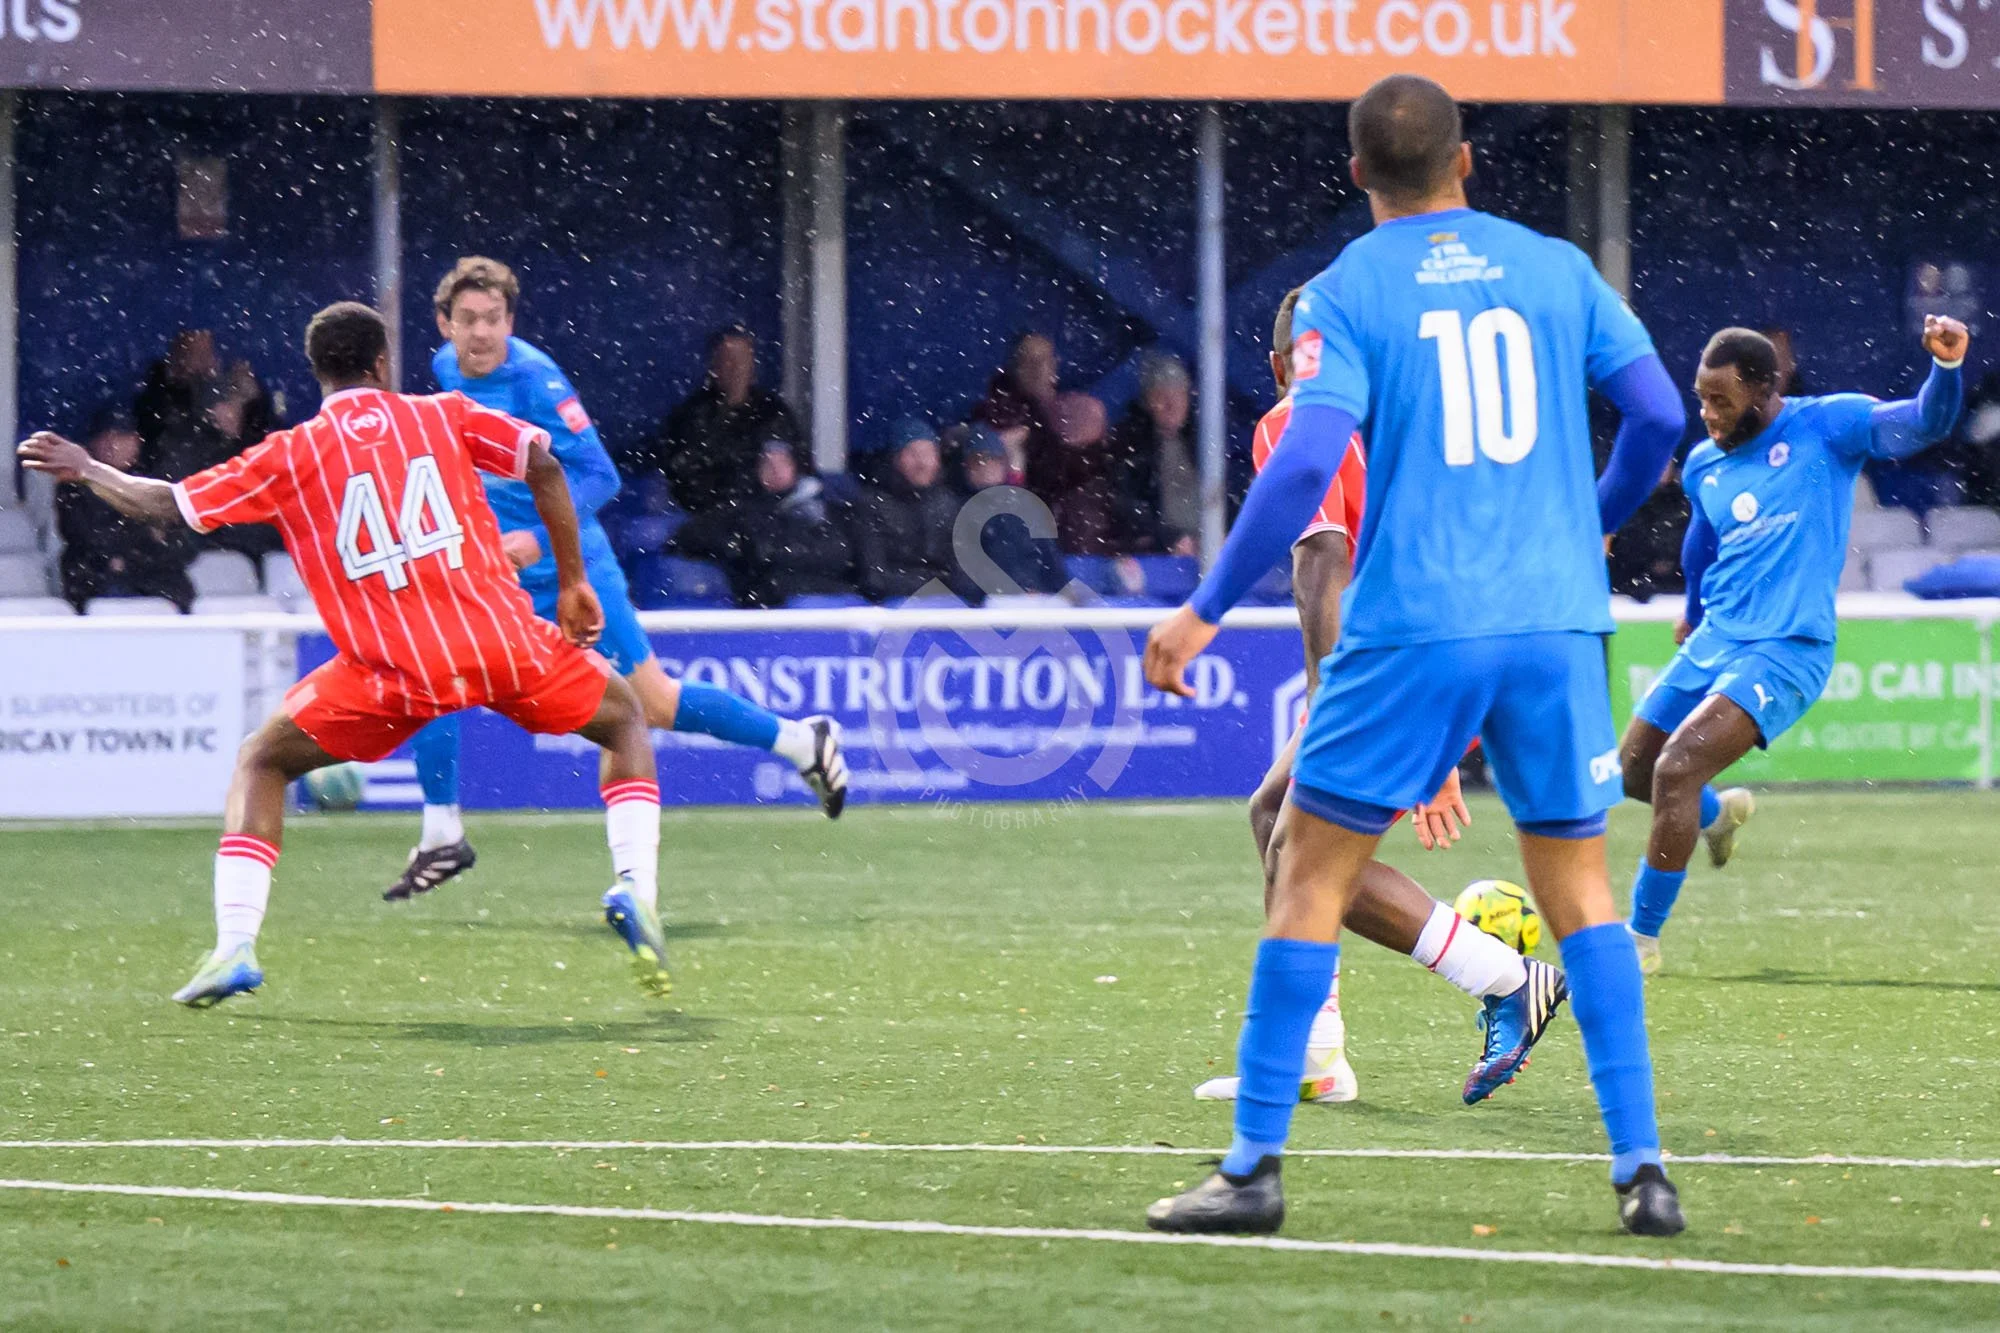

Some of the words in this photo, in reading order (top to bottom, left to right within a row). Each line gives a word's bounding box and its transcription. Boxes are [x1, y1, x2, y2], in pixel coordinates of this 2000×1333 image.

[1418, 307, 1538, 465] 10
[336, 454, 465, 591] 44
[1122, 654, 1250, 710] LD.
[1870, 661, 1945, 701] CAR
[84, 727, 175, 754] TOWN
[181, 727, 219, 754] FC
